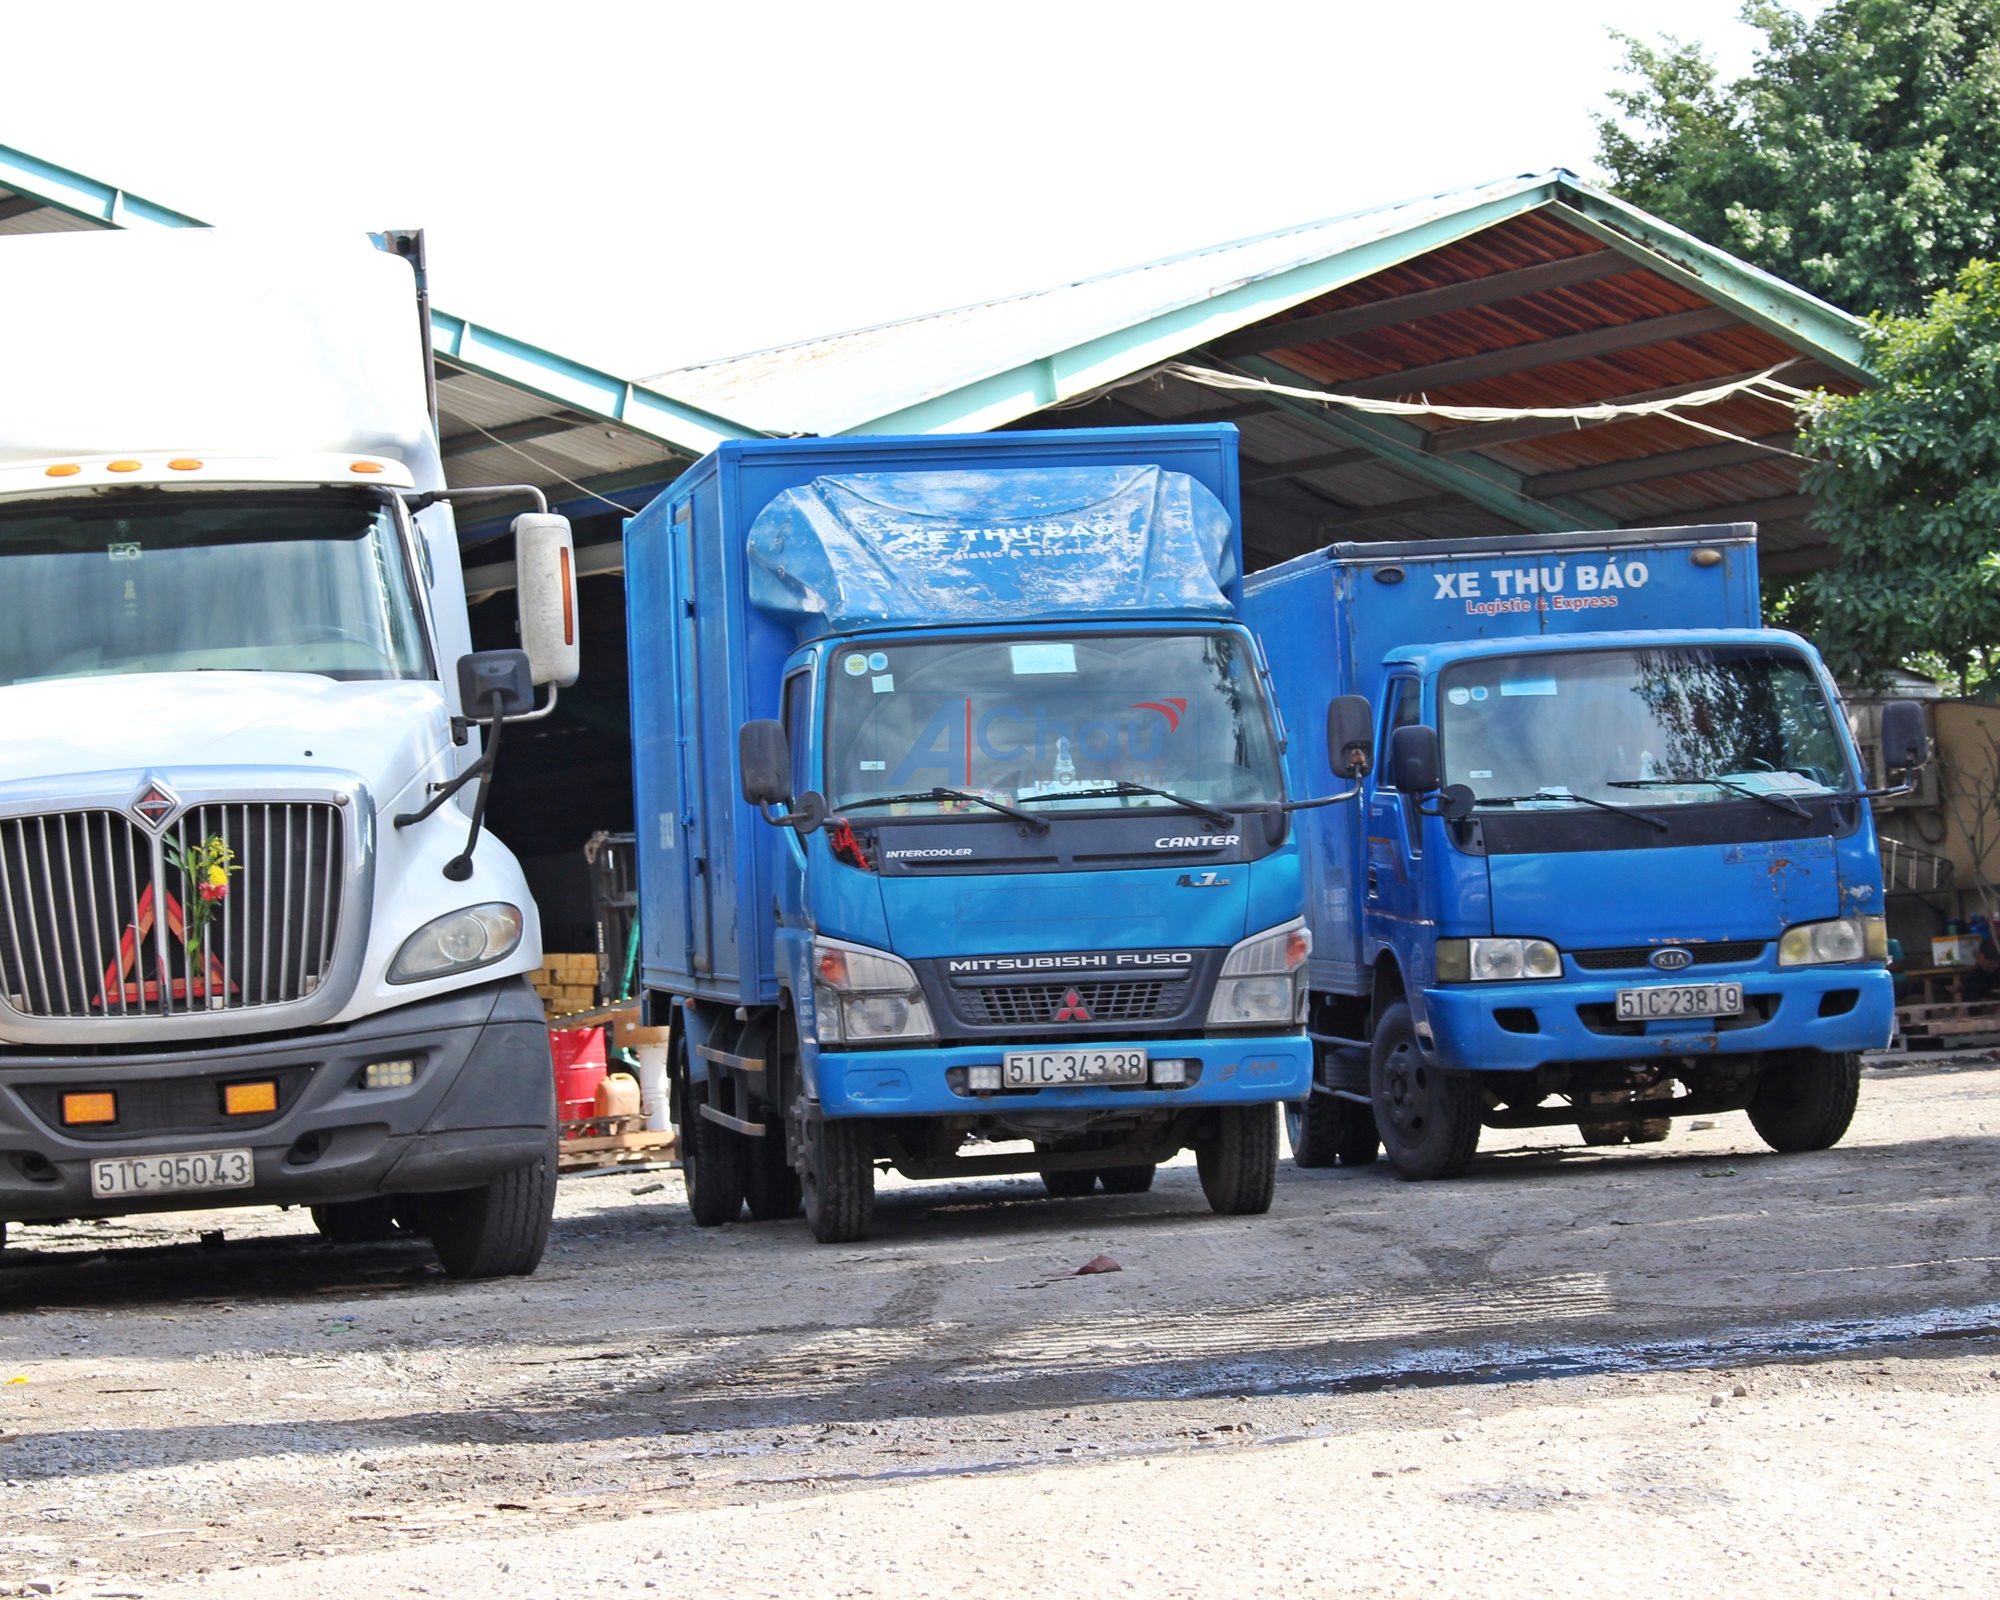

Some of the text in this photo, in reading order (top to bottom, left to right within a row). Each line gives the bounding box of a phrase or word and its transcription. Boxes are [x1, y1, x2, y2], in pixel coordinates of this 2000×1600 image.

[1028, 547, 1106, 557] Expres
[1434, 556, 1650, 600] XE THƯ BÁO
[1466, 595, 1619, 617] Logistic & Express
[1155, 835, 1240, 848] CANTER
[886, 848, 973, 858] INTERCOOLER
[950, 953, 1192, 971] MITSUBISHI FUSO
[1660, 955, 1686, 965] KIA
